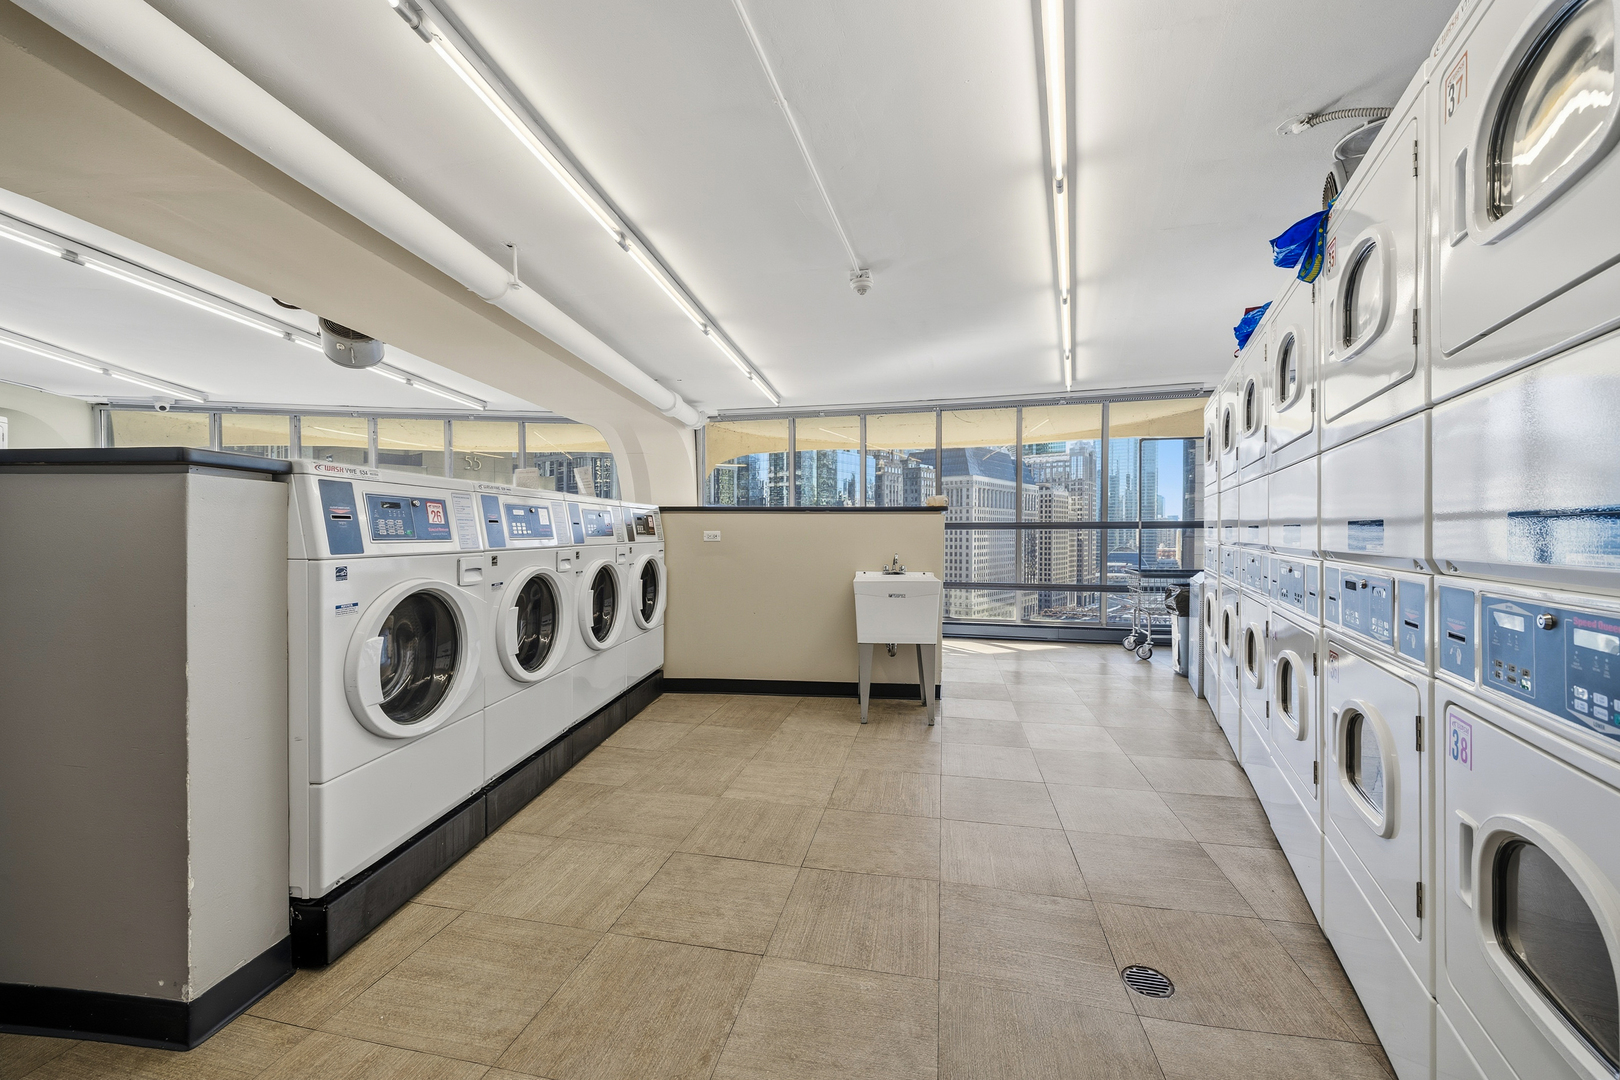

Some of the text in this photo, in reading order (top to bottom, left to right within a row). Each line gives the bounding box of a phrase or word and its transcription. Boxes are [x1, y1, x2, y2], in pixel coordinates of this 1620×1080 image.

[1448, 73, 1463, 118] 37
[324, 465, 344, 473] WASH
[463, 455, 482, 471] 55
[430, 509, 443, 523] 26
[1573, 616, 1597, 630] Speed
[1452, 728, 1468, 764] 38
